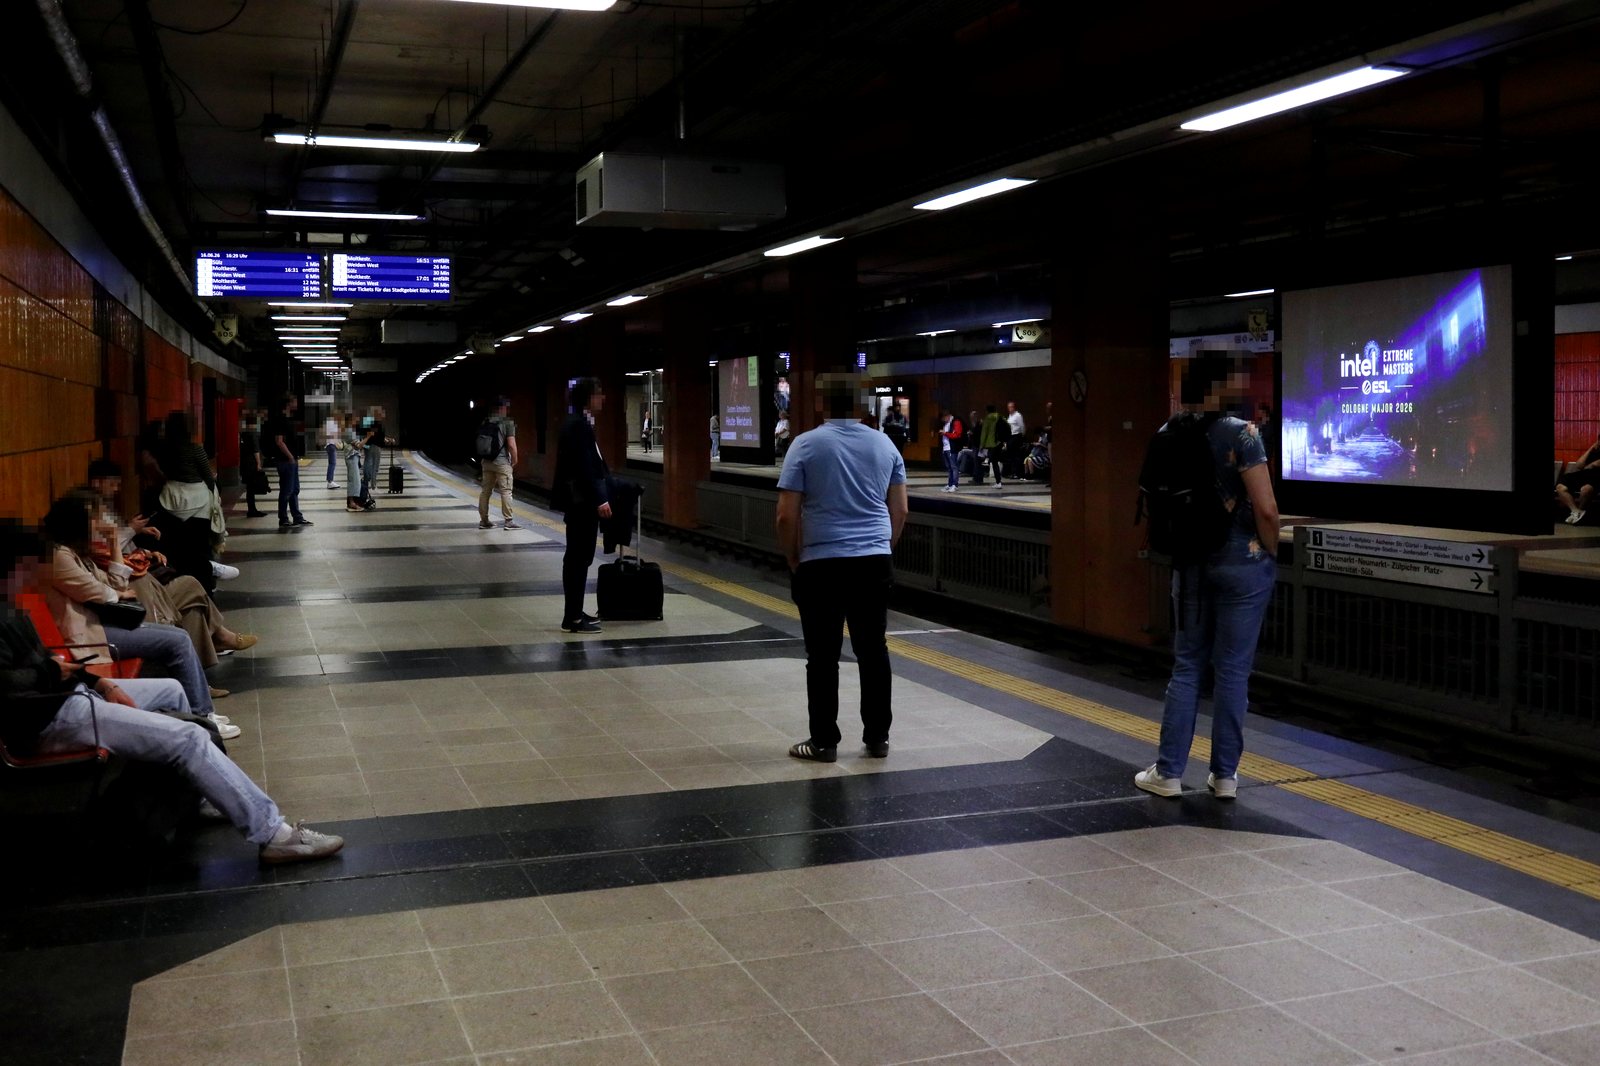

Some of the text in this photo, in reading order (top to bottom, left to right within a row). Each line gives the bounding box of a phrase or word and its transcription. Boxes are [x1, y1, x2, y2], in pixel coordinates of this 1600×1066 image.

[1383, 349, 1413, 362] EXTREME
[1383, 362, 1414, 375] MASTERS
[1372, 380, 1391, 393] ESL
[1341, 402, 1413, 413] COLOGNE MAJOR 2026
[1326, 533, 1345, 541] Neumarkt
[1375, 538, 1395, 546] Aachener
[1403, 549, 1429, 557] Junkersdorf
[1391, 561, 1420, 573] Zülpicher
